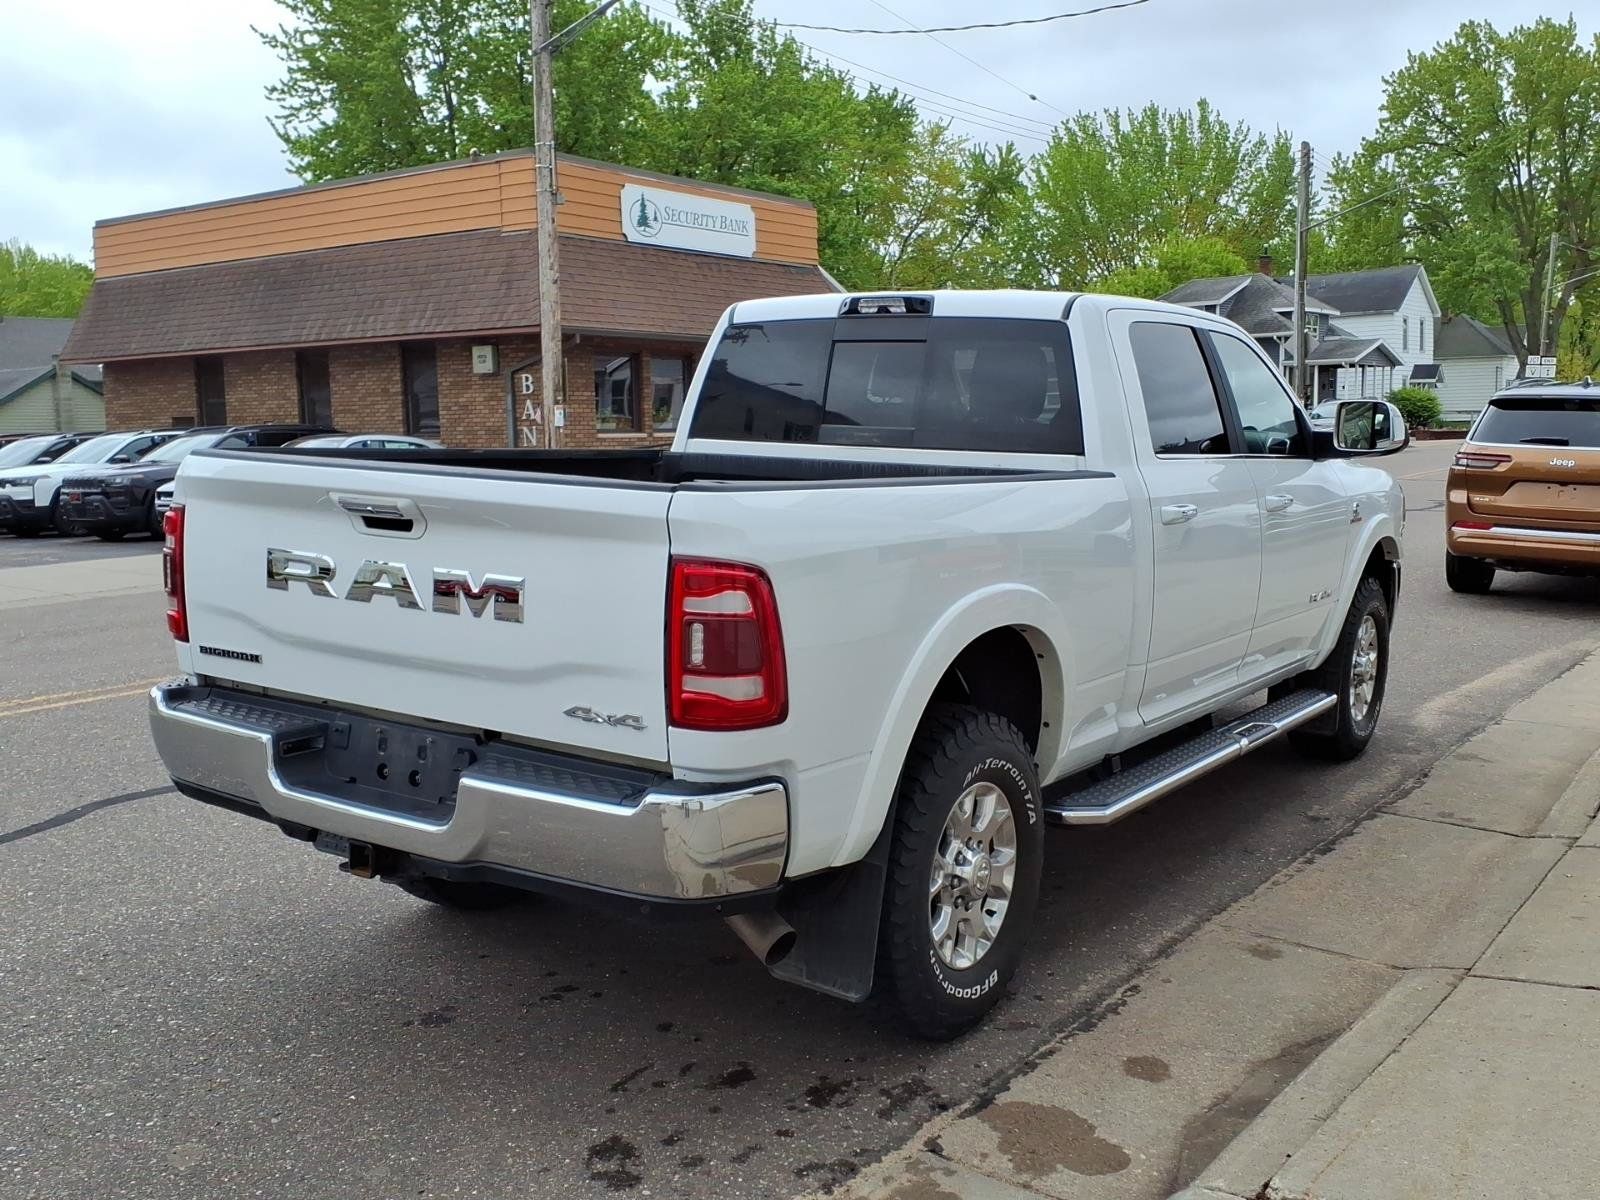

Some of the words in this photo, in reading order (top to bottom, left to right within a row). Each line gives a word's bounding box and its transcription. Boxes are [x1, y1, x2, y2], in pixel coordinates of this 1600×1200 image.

[664, 206, 720, 230] SECURITY
[719, 215, 749, 234] BANK
[1549, 457, 1576, 468] Jeep
[266, 547, 526, 624] RAM
[1023, 790, 1037, 825] T/A
